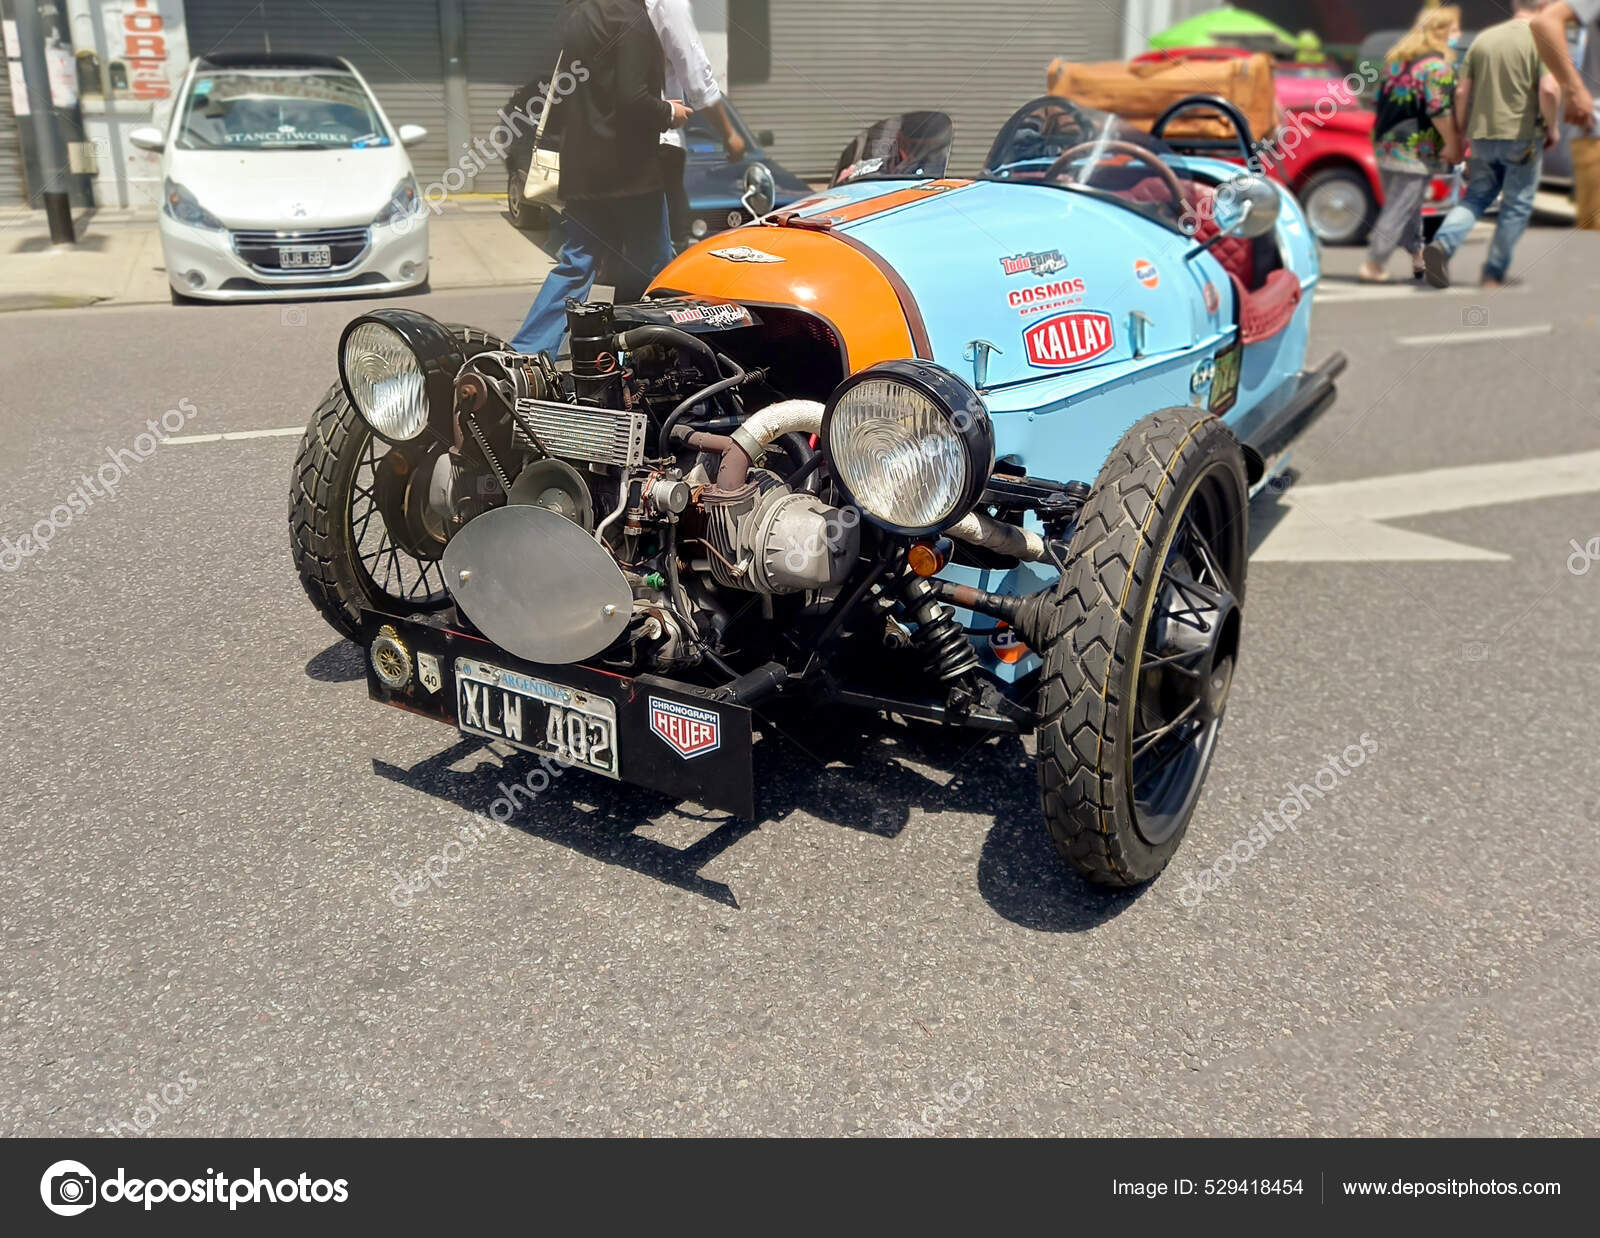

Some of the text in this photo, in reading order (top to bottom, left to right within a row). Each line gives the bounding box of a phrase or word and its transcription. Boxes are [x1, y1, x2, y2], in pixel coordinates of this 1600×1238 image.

[123, 0, 171, 99] ORES
[1008, 278, 1086, 307] COSMOS
[1033, 318, 1106, 360] KALLAY
[424, 674, 438, 688] 40
[502, 673, 566, 699] ARGENTINA
[463, 680, 610, 770] XLW 402
[652, 700, 717, 723] CHRONOGRAPH
[657, 712, 712, 749] HEUER
